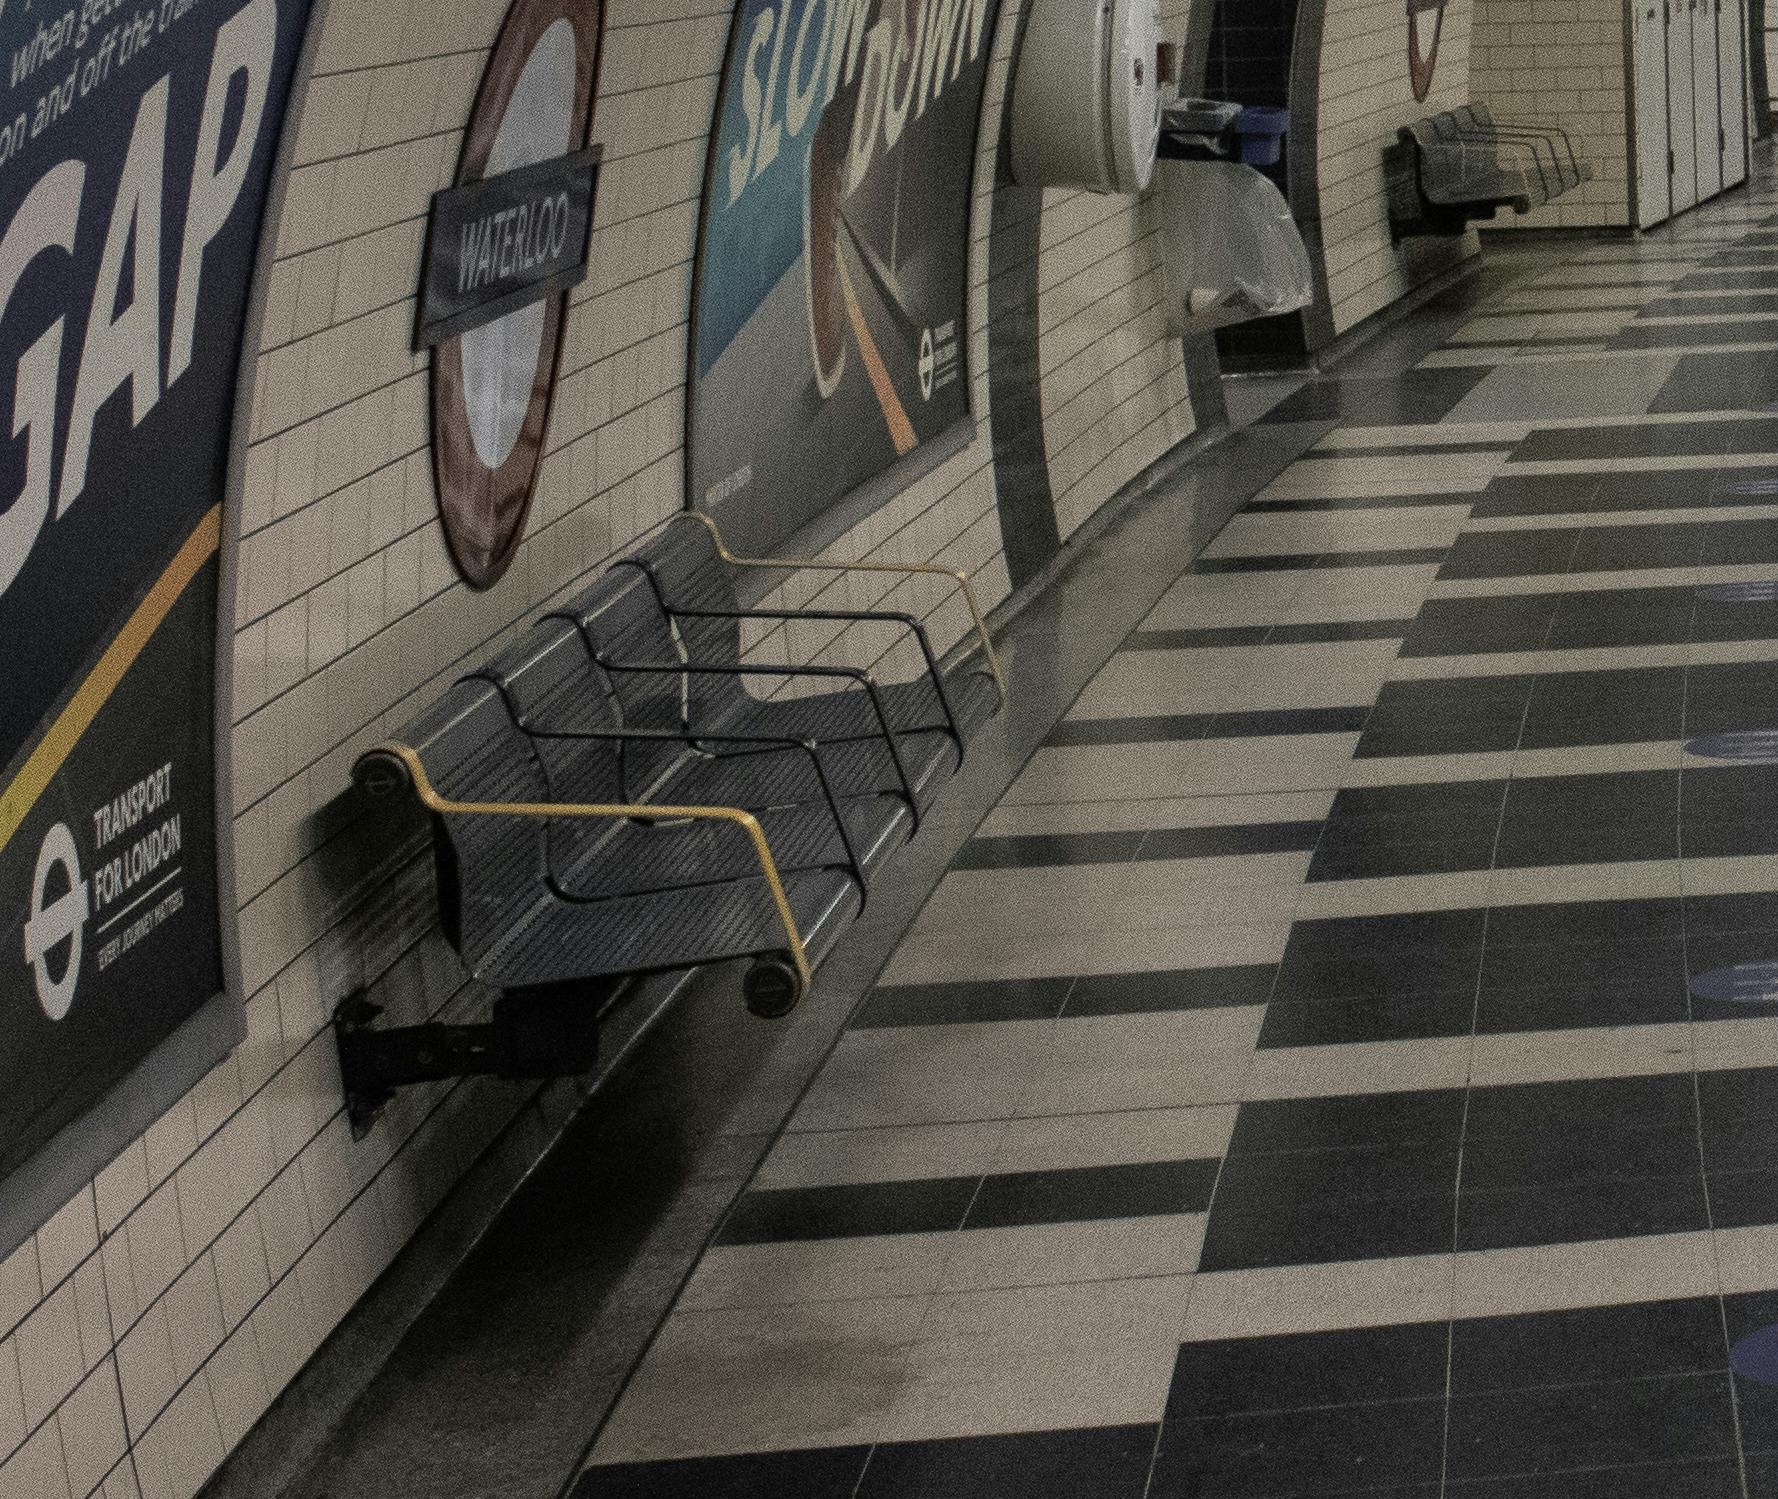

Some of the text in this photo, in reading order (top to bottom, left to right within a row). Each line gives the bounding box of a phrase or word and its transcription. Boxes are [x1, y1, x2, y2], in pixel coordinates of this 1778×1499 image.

[11, 10, 75, 88] when
[31, 58, 79, 139] and
[80, 26, 122, 97] off
[119, 6, 156, 66] the
[457, 192, 569, 294] WATERLOO
[93, 761, 172, 849] TRANSPORT
[95, 813, 182, 912] FOR LONDON
